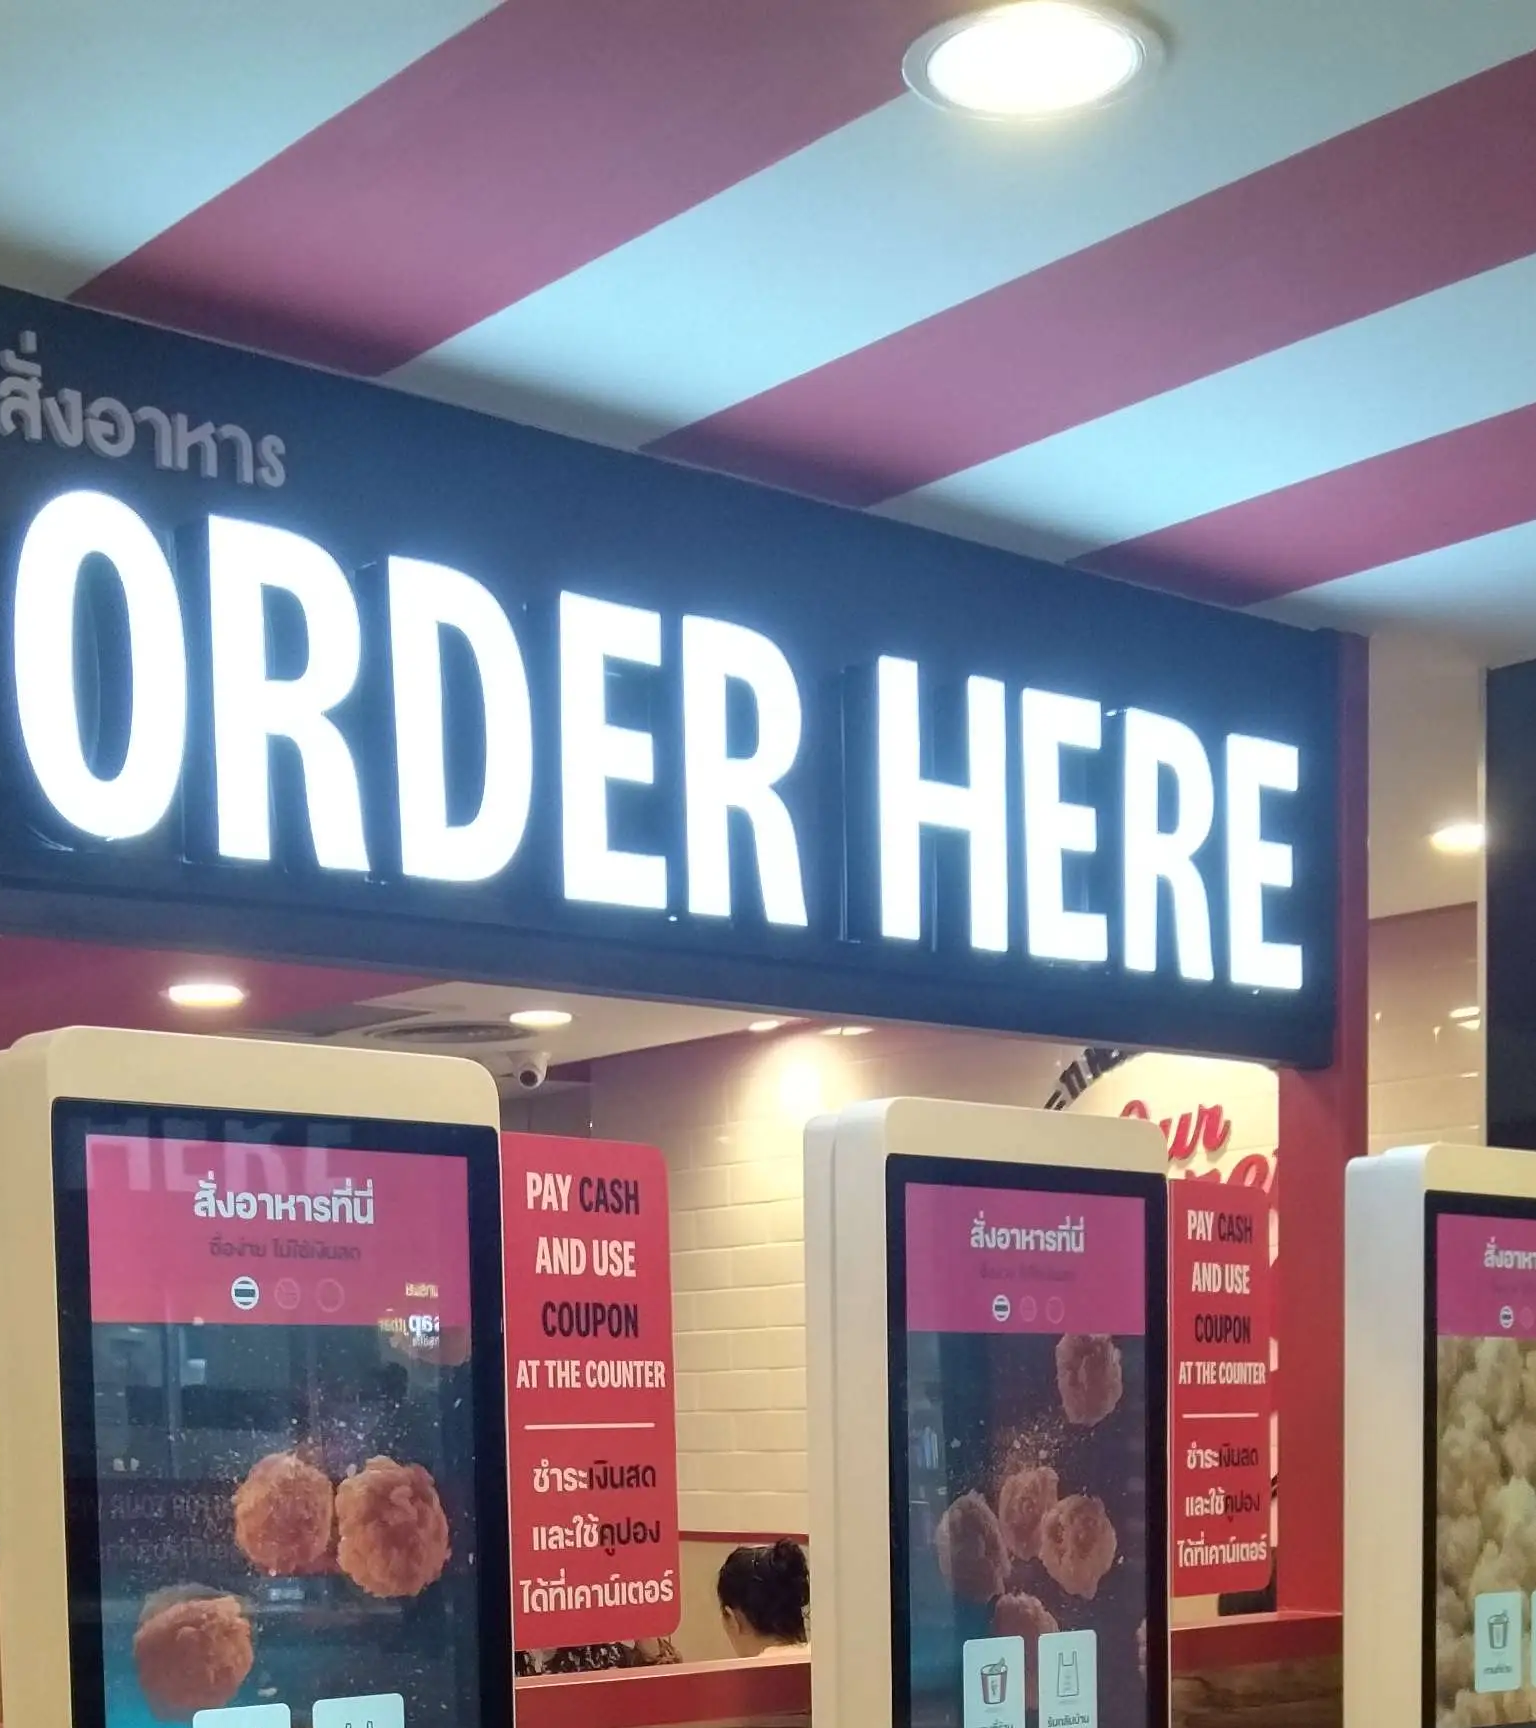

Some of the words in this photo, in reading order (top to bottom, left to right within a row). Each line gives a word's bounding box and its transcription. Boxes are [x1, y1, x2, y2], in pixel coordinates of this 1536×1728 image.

[14, 490, 808, 927] ORDER
[876, 654, 1303, 990] HERE
[194, 1170, 374, 1225] สั่งอาหารที่นี่
[526, 1172, 573, 1212] PAY
[579, 1176, 640, 1215] CASH
[970, 1211, 1085, 1253] สั่งอาหารที่นี่
[1187, 1209, 1214, 1242] PAY
[1218, 1213, 1253, 1244] CASH
[535, 1236, 587, 1275] AND
[592, 1240, 636, 1277] USE
[1191, 1262, 1221, 1293] AND
[1224, 1264, 1250, 1294] USE
[542, 1301, 639, 1338] COUPON
[1194, 1313, 1251, 1343] COUPON
[516, 1359, 540, 1389] AT
[544, 1359, 581, 1388] THE
[585, 1360, 666, 1388] COUNTER
[1178, 1361, 1193, 1385] AT
[1195, 1361, 1217, 1385] THE
[1219, 1362, 1266, 1385] COUNTER
[1187, 1441, 1259, 1470] ชำระเงินสด
[532, 1459, 657, 1493] ชำระเงินสด
[1185, 1487, 1260, 1522] และใช้คูปอง
[532, 1513, 661, 1556] และใช้คูปอง
[1177, 1531, 1268, 1568] ได้ที่เคาน์เตอร์
[519, 1568, 674, 1614] ได้ที่เคาน์เตอร์
